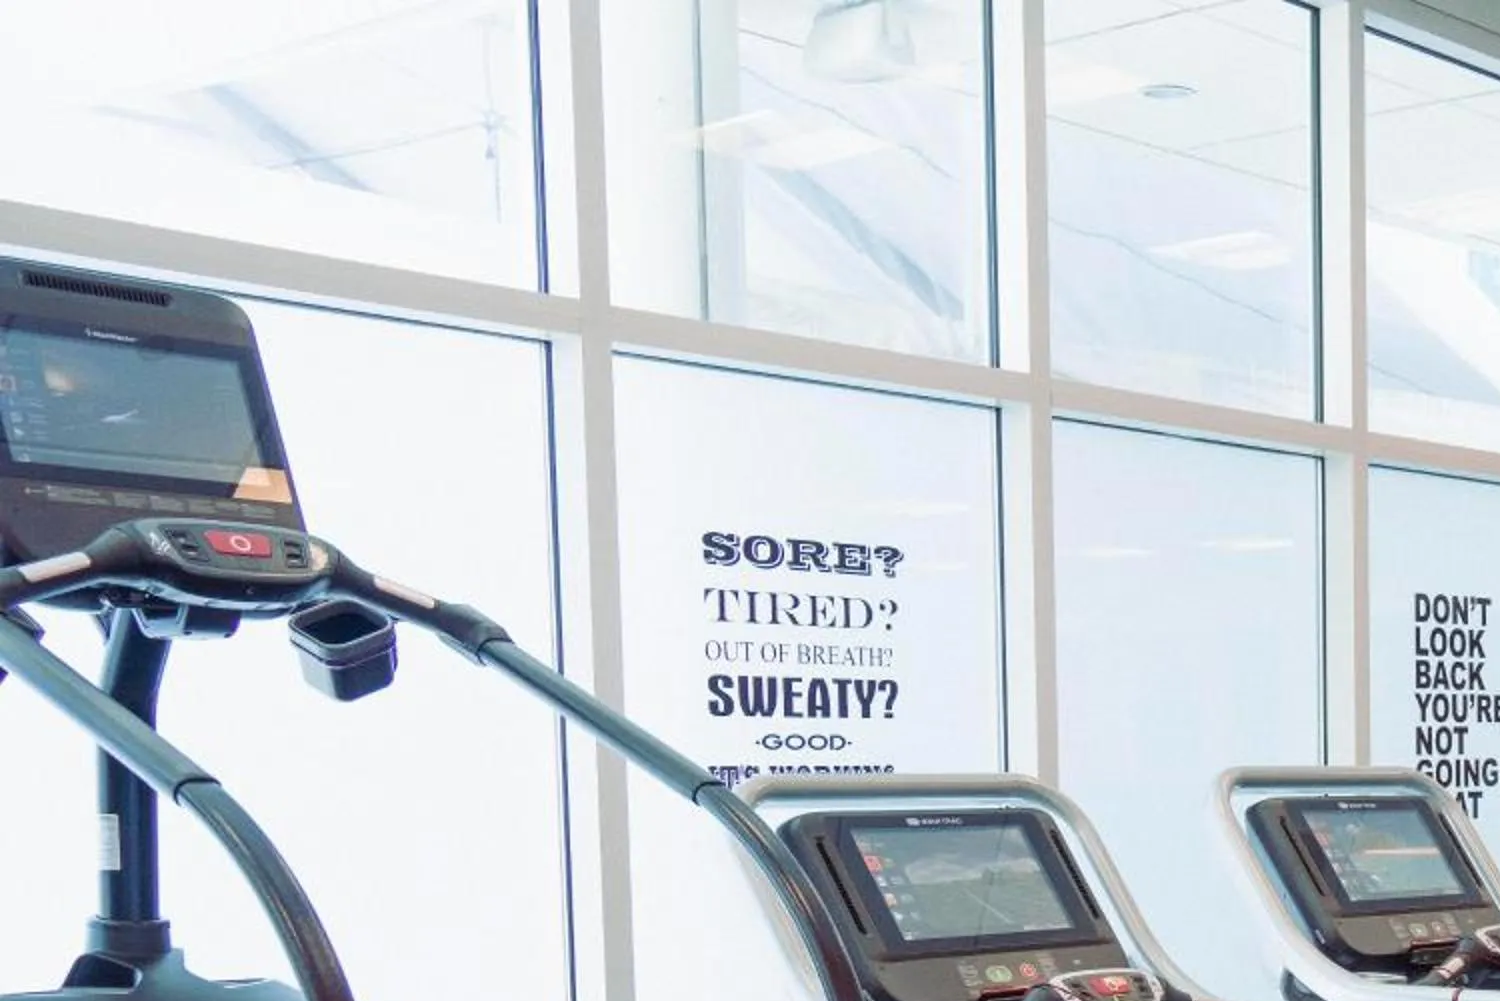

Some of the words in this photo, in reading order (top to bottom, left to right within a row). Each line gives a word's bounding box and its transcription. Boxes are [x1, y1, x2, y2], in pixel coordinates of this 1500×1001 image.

[701, 531, 904, 578] SORE?
[703, 588, 899, 631] TIRED?
[1414, 593, 1492, 626] DON'T
[704, 640, 754, 663] OUT
[760, 641, 791, 664] OF
[798, 643, 894, 668] BREATH?
[1415, 626, 1486, 658] LOOK
[1415, 659, 1486, 690] BACK
[707, 674, 899, 719] SWEATY?
[1415, 726, 1469, 755] NOT
[1416, 758, 1499, 787] GOING
